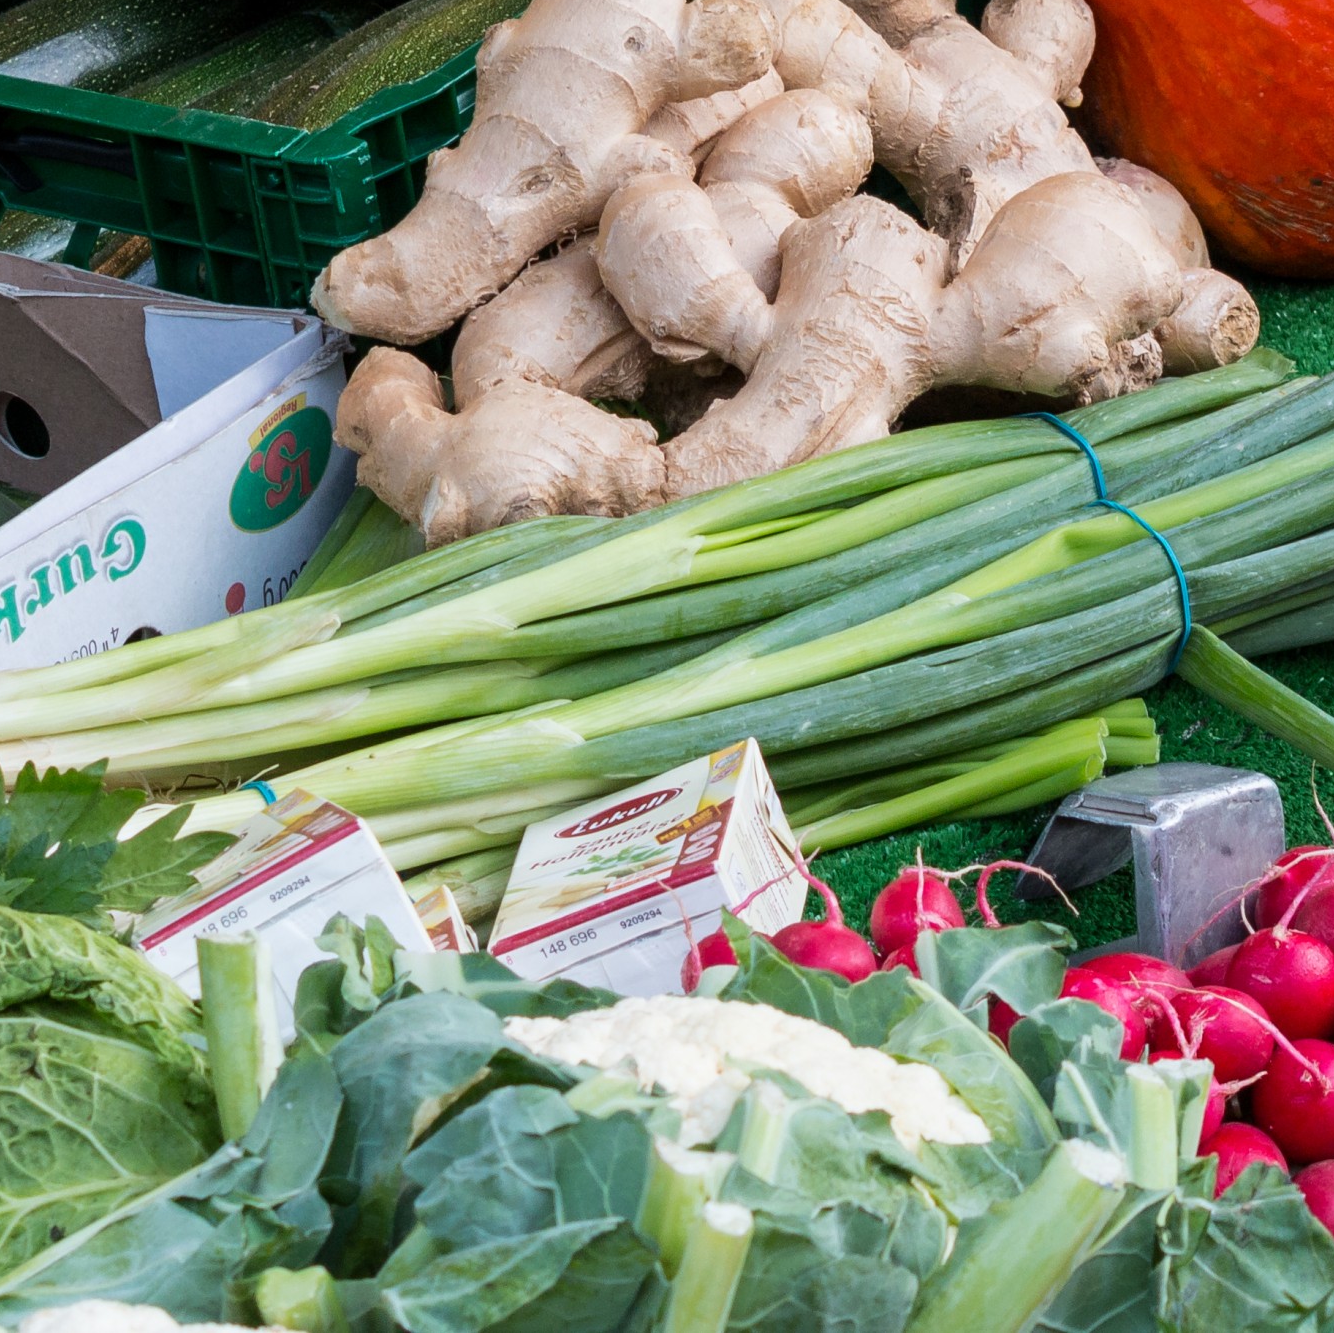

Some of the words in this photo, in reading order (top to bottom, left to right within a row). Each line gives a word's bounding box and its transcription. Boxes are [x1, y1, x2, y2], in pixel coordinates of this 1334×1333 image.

[259, 398, 298, 439] Regional
[570, 791, 669, 835] Lukull
[528, 811, 687, 871] Hollandaise
[573, 820, 652, 852] Sauce
[268, 874, 312, 904] 9209294
[219, 905, 249, 930] 696
[619, 907, 663, 931] 9209294
[539, 939, 568, 960] 148
[569, 927, 598, 948] 696
